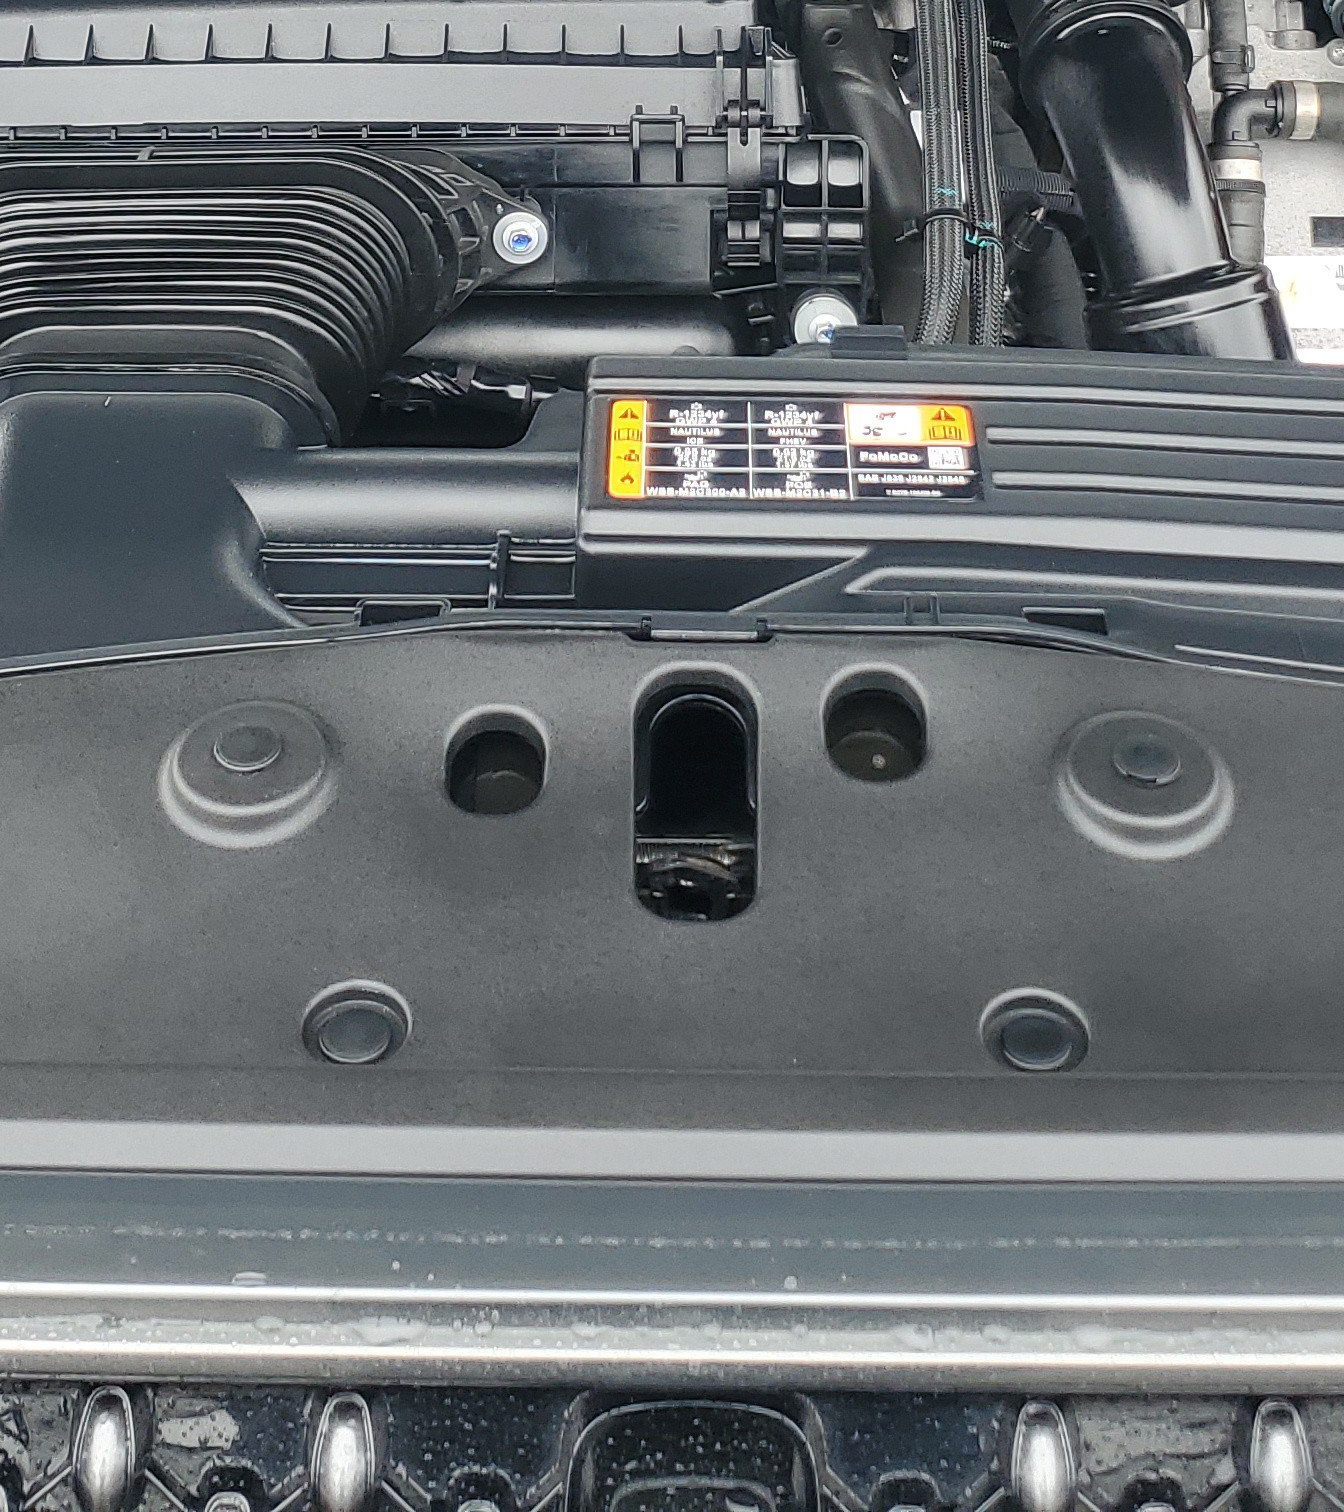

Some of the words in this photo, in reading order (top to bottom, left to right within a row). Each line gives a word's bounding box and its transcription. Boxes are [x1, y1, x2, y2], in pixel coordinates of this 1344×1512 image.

[669, 409, 725, 419] R-1234yf
[764, 410, 820, 419] R-1234yf
[670, 427, 721, 436] NAUTILUS
[768, 428, 818, 436] NAUTILUS
[859, 451, 919, 462] FoMoCo
